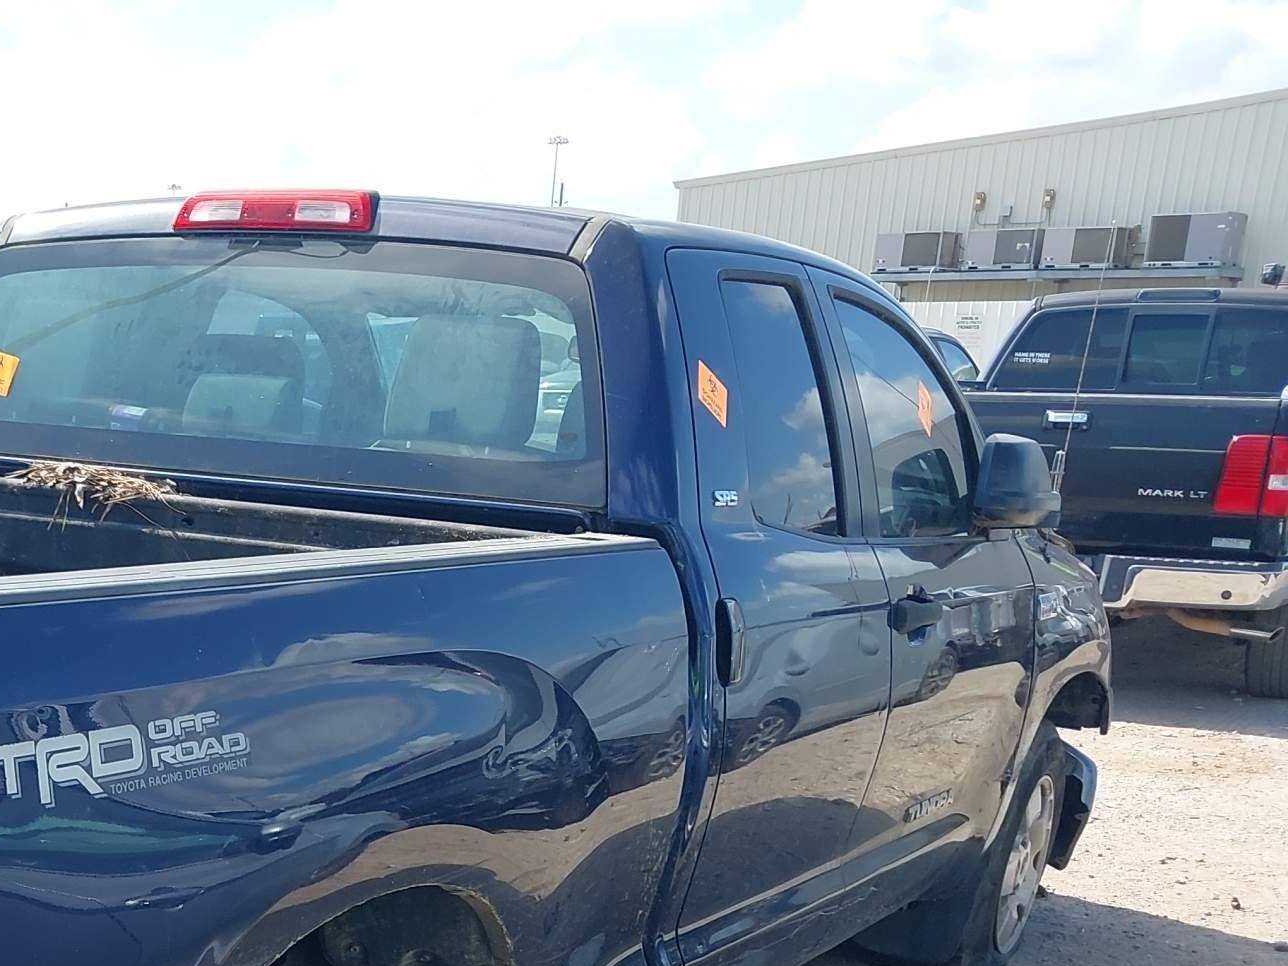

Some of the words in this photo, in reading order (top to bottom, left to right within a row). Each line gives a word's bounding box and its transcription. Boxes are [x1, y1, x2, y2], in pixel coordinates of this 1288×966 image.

[1137, 488, 1184, 498] MARK
[1189, 490, 1209, 499] LT
[147, 710, 220, 741] OFF
[151, 732, 250, 770] ROAD
[109, 778, 147, 795] TOYOTA
[148, 771, 183, 787] RACING
[185, 757, 249, 782] DEVELOPMENT
